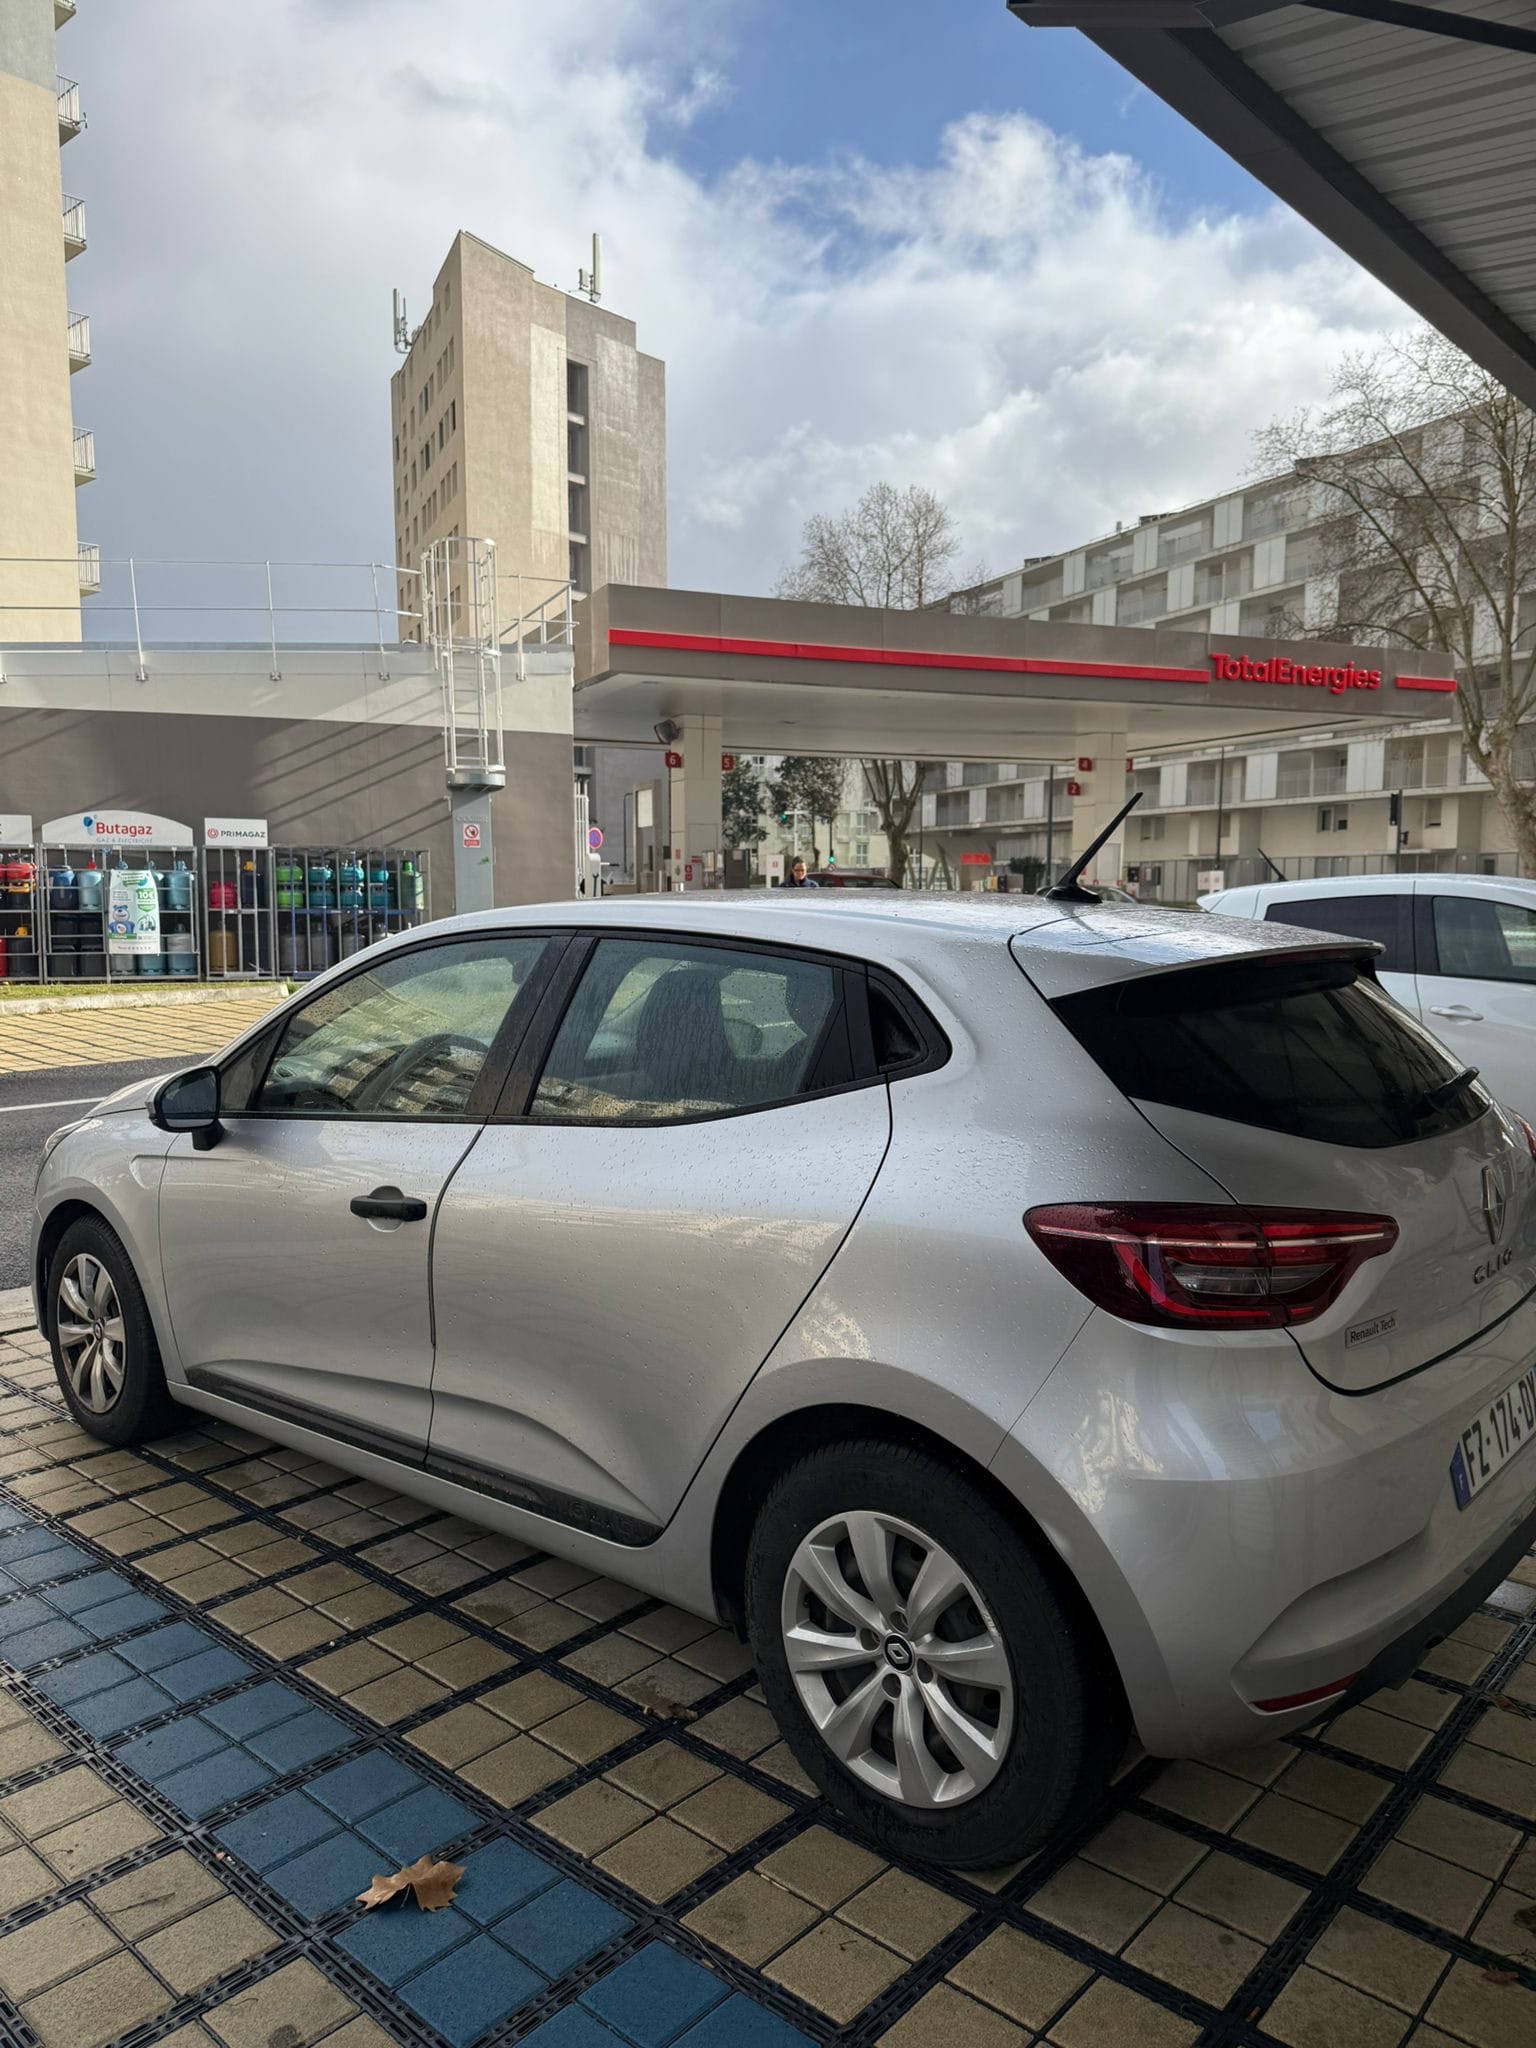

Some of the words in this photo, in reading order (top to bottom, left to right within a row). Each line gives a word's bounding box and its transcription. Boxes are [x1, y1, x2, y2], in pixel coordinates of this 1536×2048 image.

[1210, 652, 1382, 695] TotalEnergies
[669, 755, 676, 765] 6
[723, 757, 730, 768] 5
[96, 822, 153, 837] Butagaz
[220, 830, 266, 838] PRIMAGAZ
[1473, 1247, 1513, 1285] CLIO
[1350, 1322, 1380, 1343] Renault
[1380, 1316, 1396, 1331] Tech
